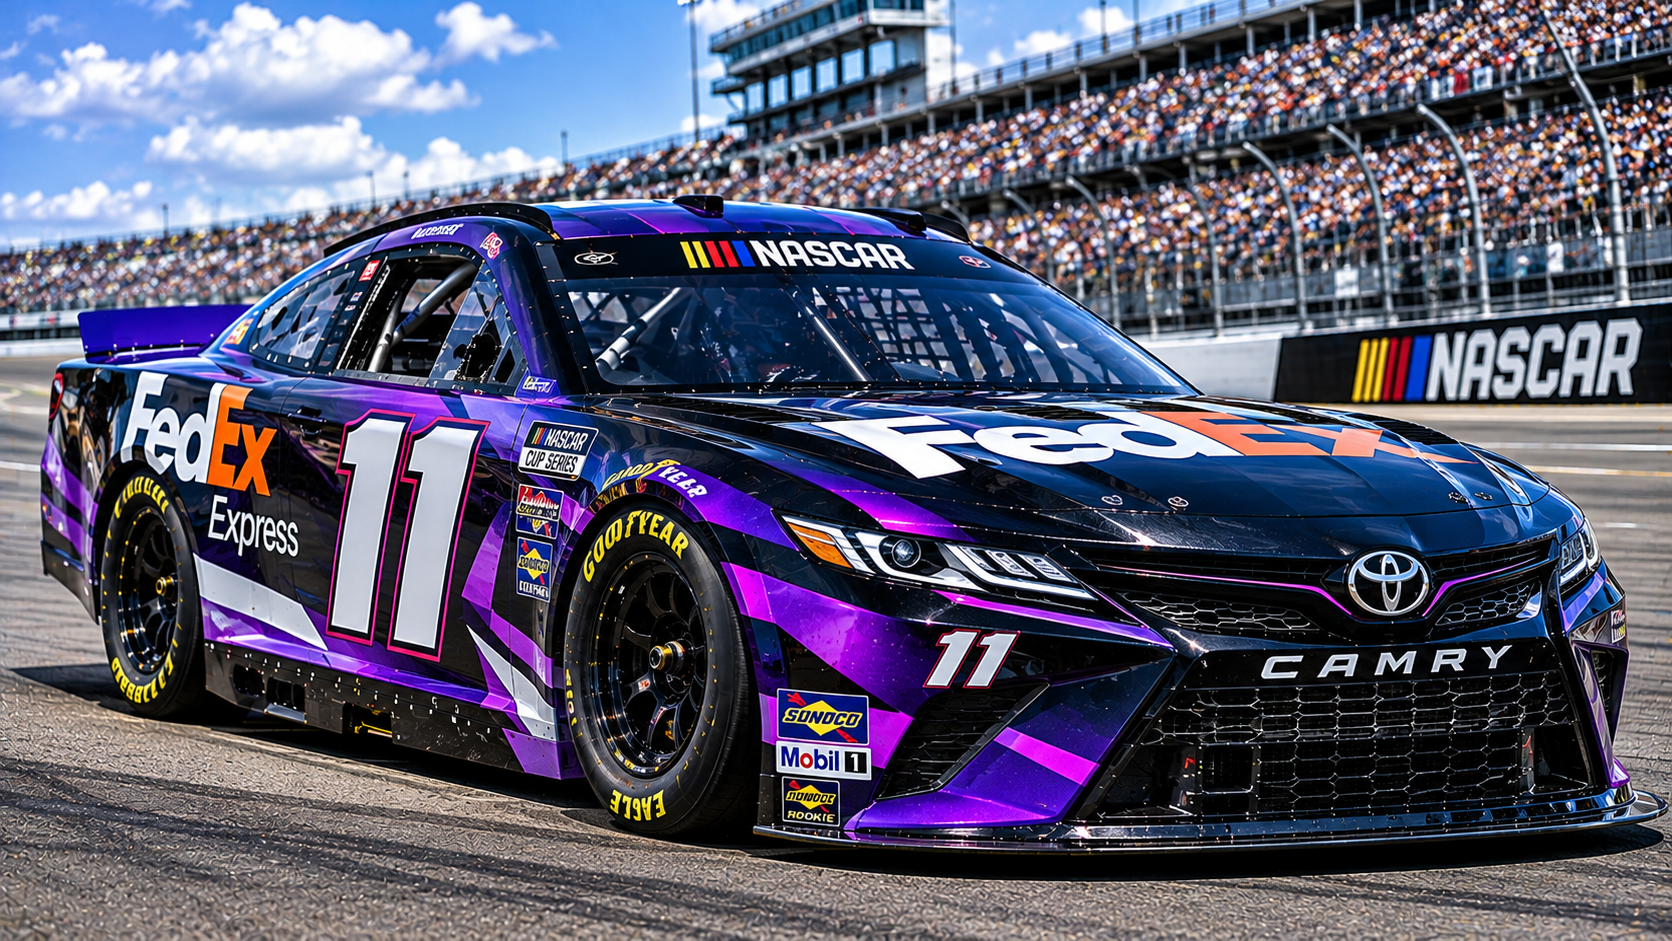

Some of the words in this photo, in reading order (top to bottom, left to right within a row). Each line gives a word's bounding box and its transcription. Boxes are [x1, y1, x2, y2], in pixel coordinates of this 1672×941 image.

[749, 240, 915, 270] NASCAR
[1425, 317, 1644, 402] NASCAR
[120, 370, 278, 497] FedEx
[543, 428, 589, 452] NASCAR
[811, 410, 1478, 479] FedEx
[525, 449, 546, 468] CUP
[545, 452, 578, 473] SERIES
[207, 494, 299, 557] Express
[325, 408, 491, 663] 11
[922, 628, 1021, 689] 11
[1260, 645, 1513, 680] CAMRY
[781, 746, 839, 771] Mobil
[850, 753, 859, 772] 1
[609, 789, 667, 821] EAGLE
